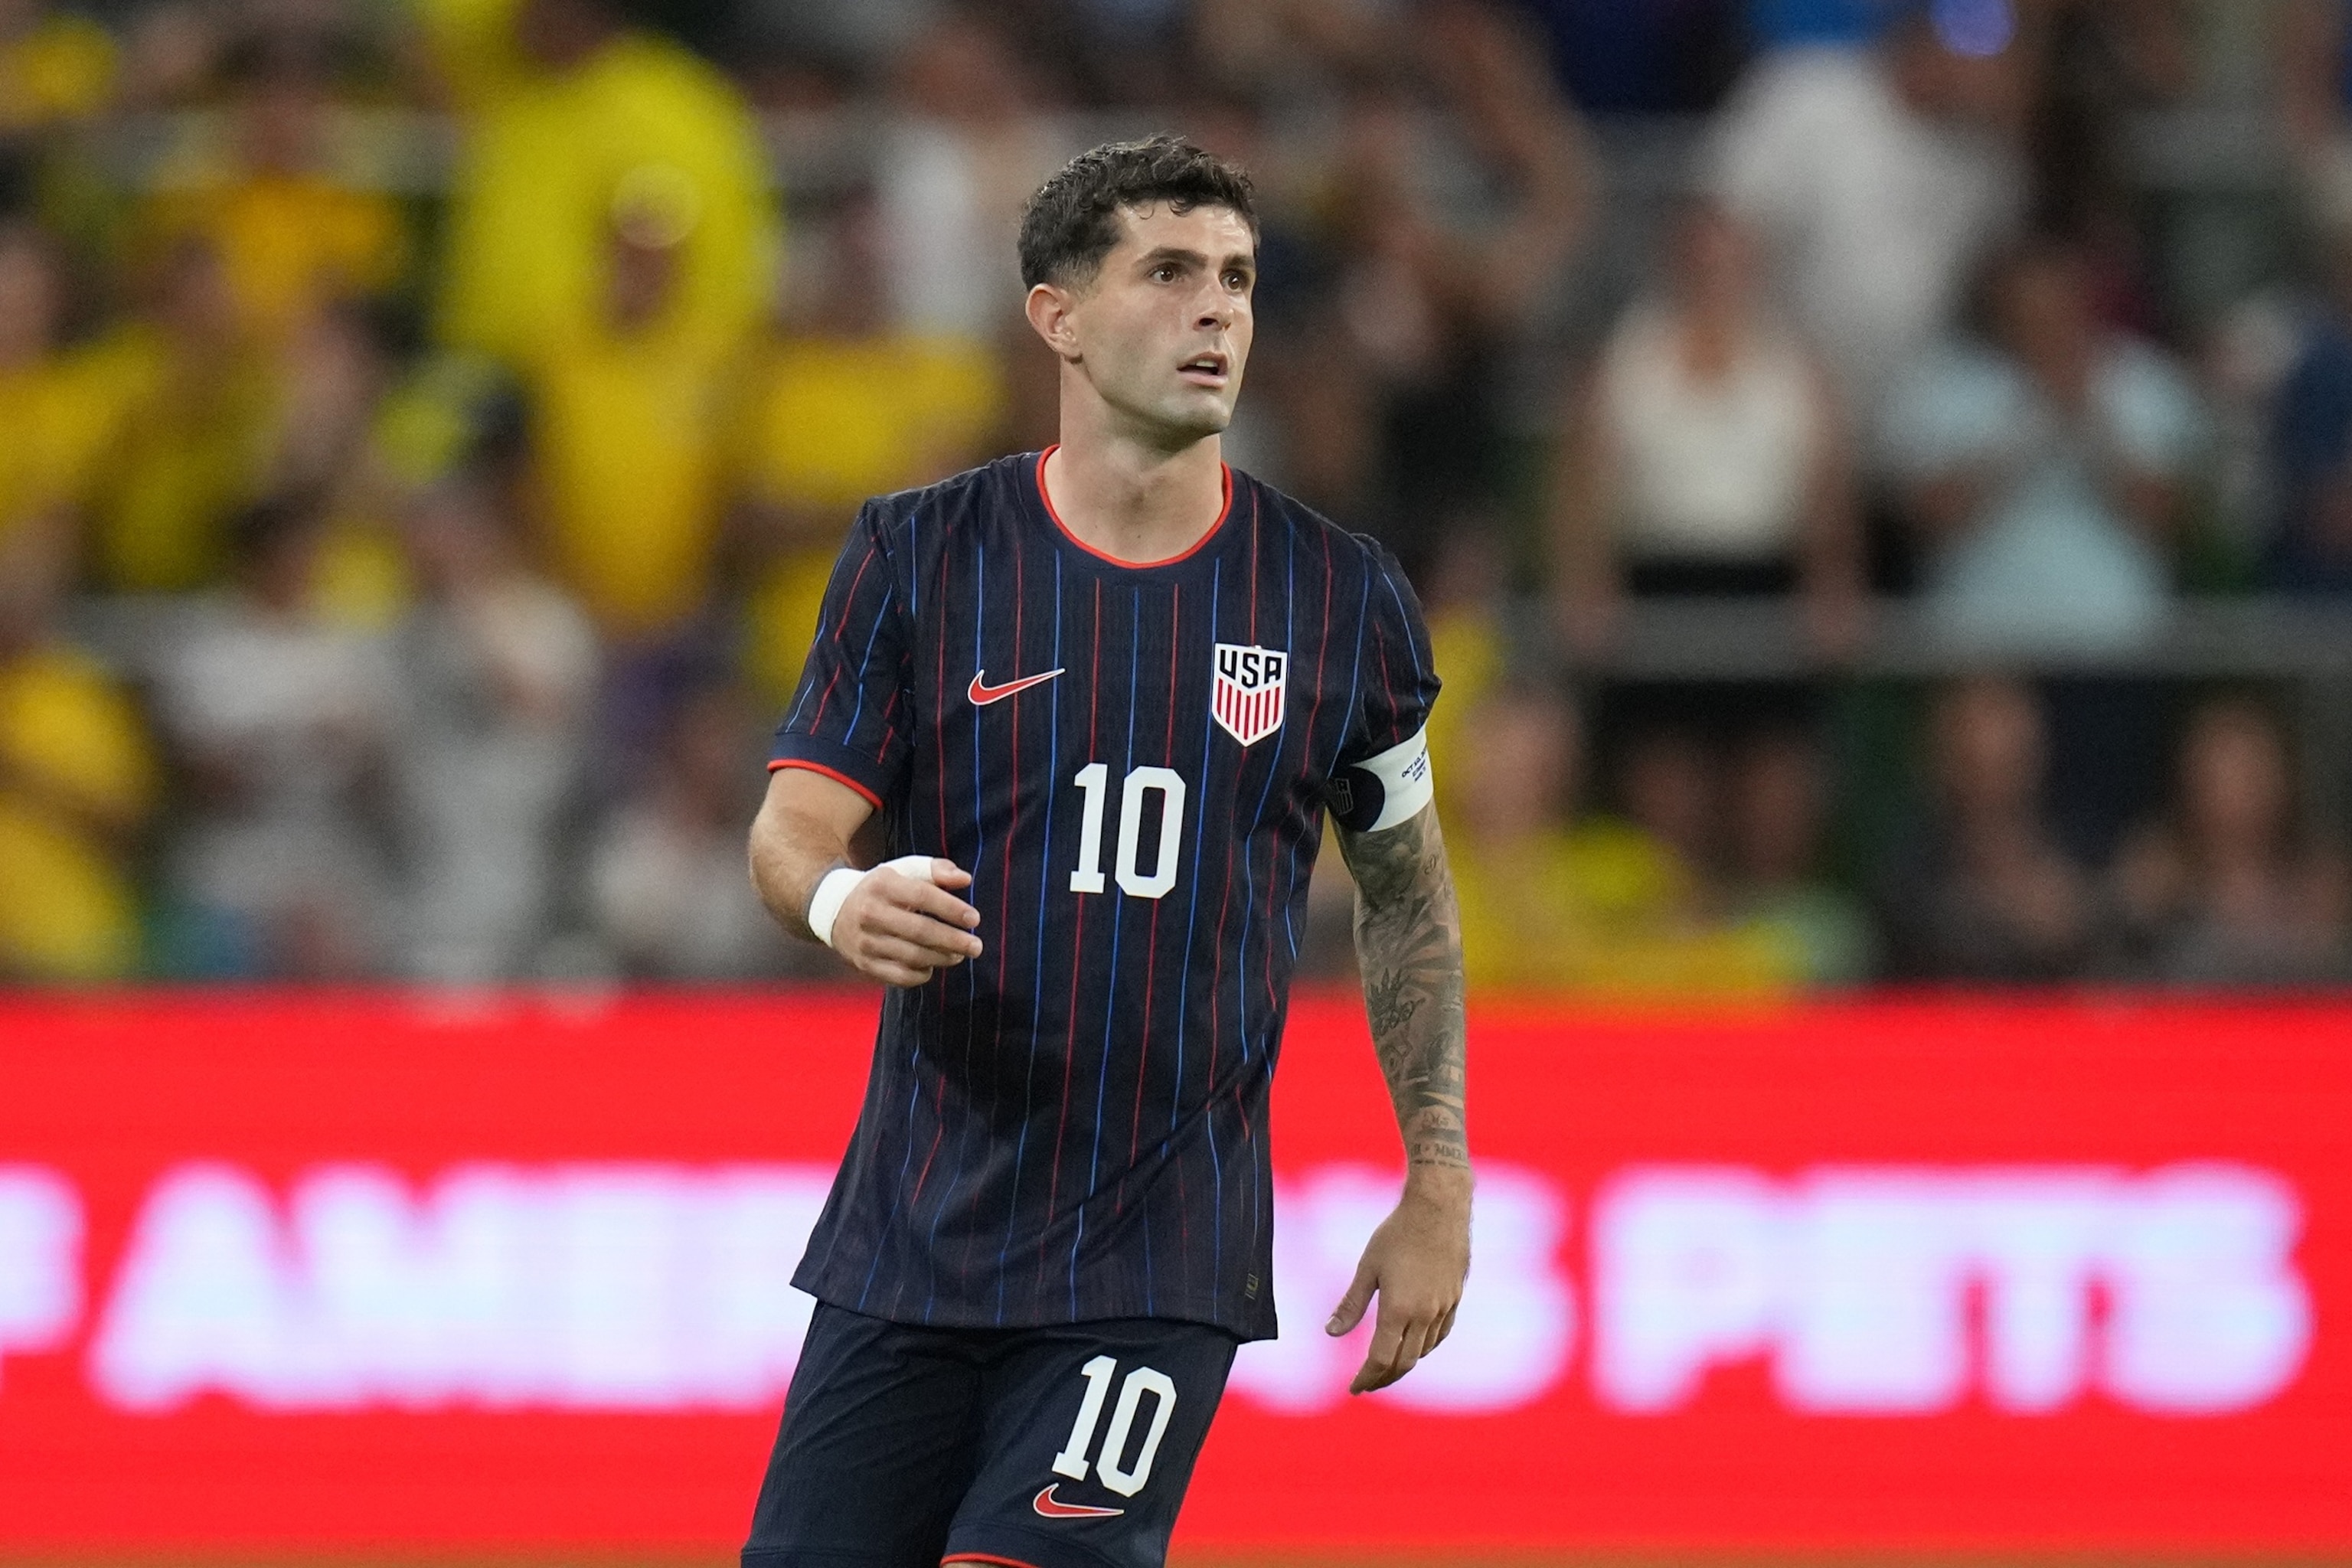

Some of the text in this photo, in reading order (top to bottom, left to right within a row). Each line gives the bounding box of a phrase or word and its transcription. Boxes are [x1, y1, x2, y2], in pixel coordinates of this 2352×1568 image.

[1219, 649, 1282, 689] USA
[1070, 763, 1186, 899] 10
[1589, 1165, 2314, 1413] PETS
[1051, 1354, 1177, 1498] 10
